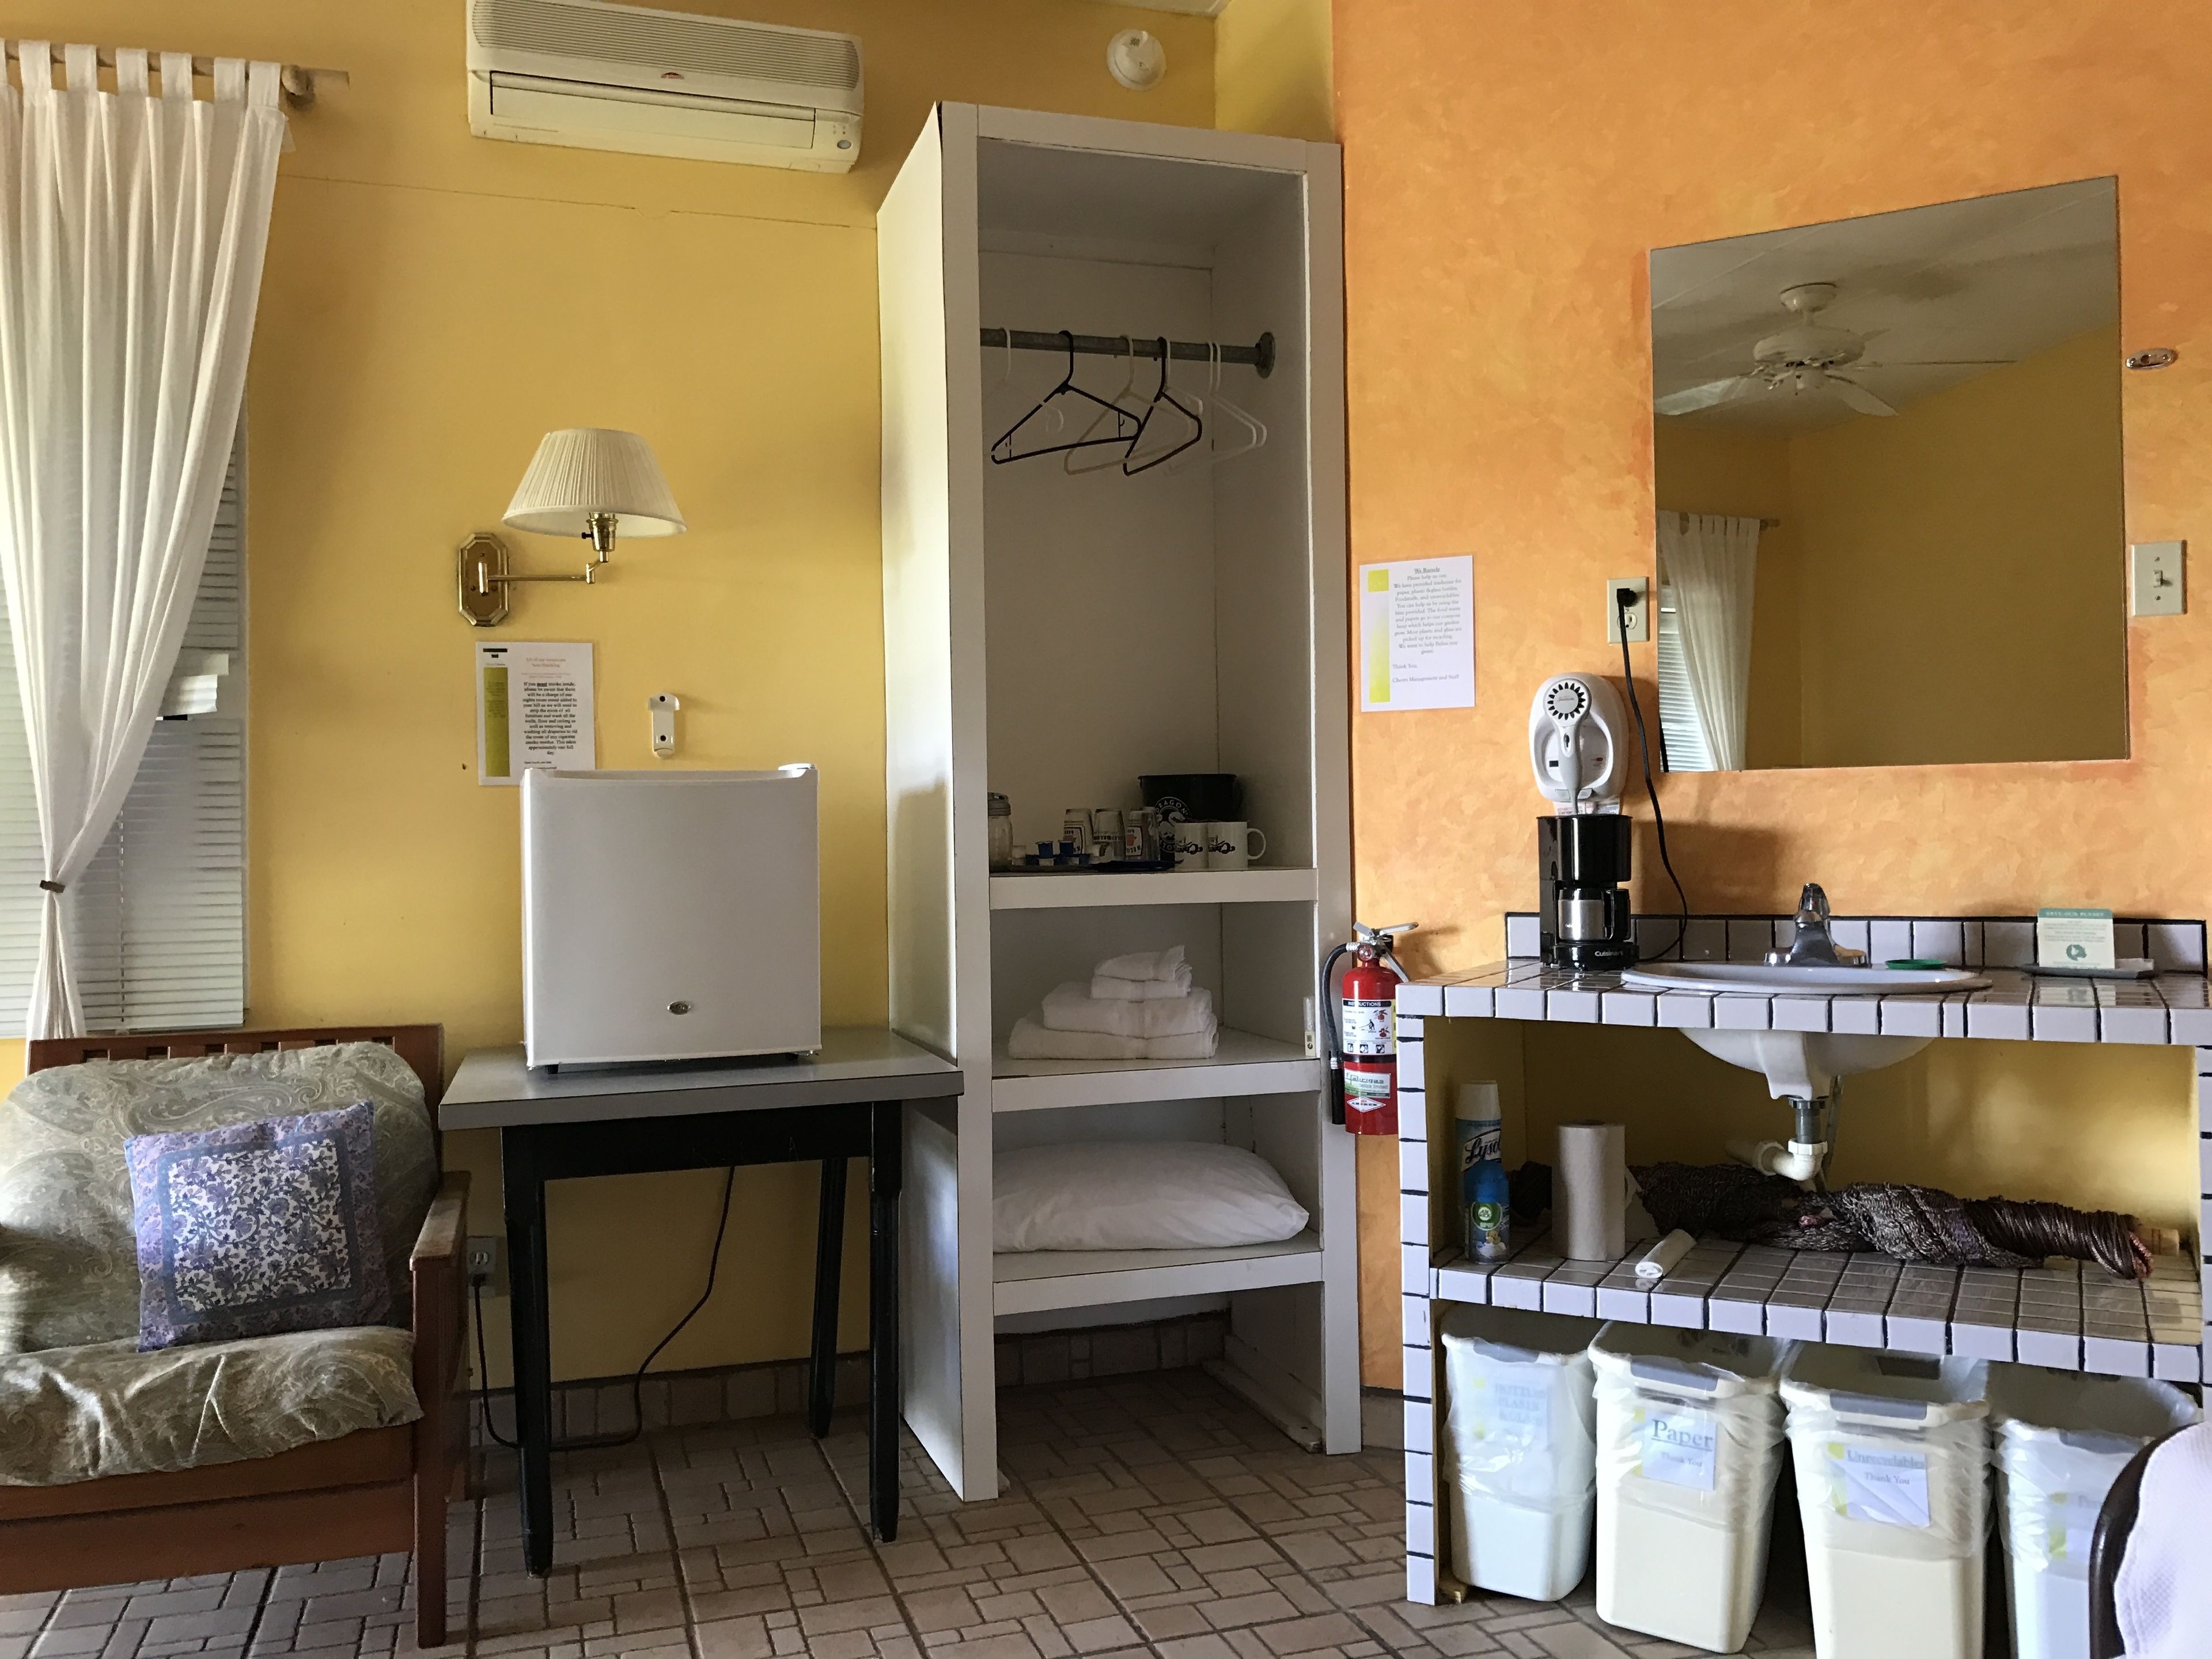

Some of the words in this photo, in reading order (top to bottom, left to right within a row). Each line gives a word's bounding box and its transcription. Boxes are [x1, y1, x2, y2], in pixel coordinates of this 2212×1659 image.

[1652, 1419, 1713, 1450] Paper
[1661, 1452, 1684, 1463] Thank
[1687, 1457, 1702, 1467] You
[1847, 1450, 1925, 1469] Unrecyclables
[1864, 1472, 1891, 1483] Thank
[1894, 1476, 1910, 1484] You
